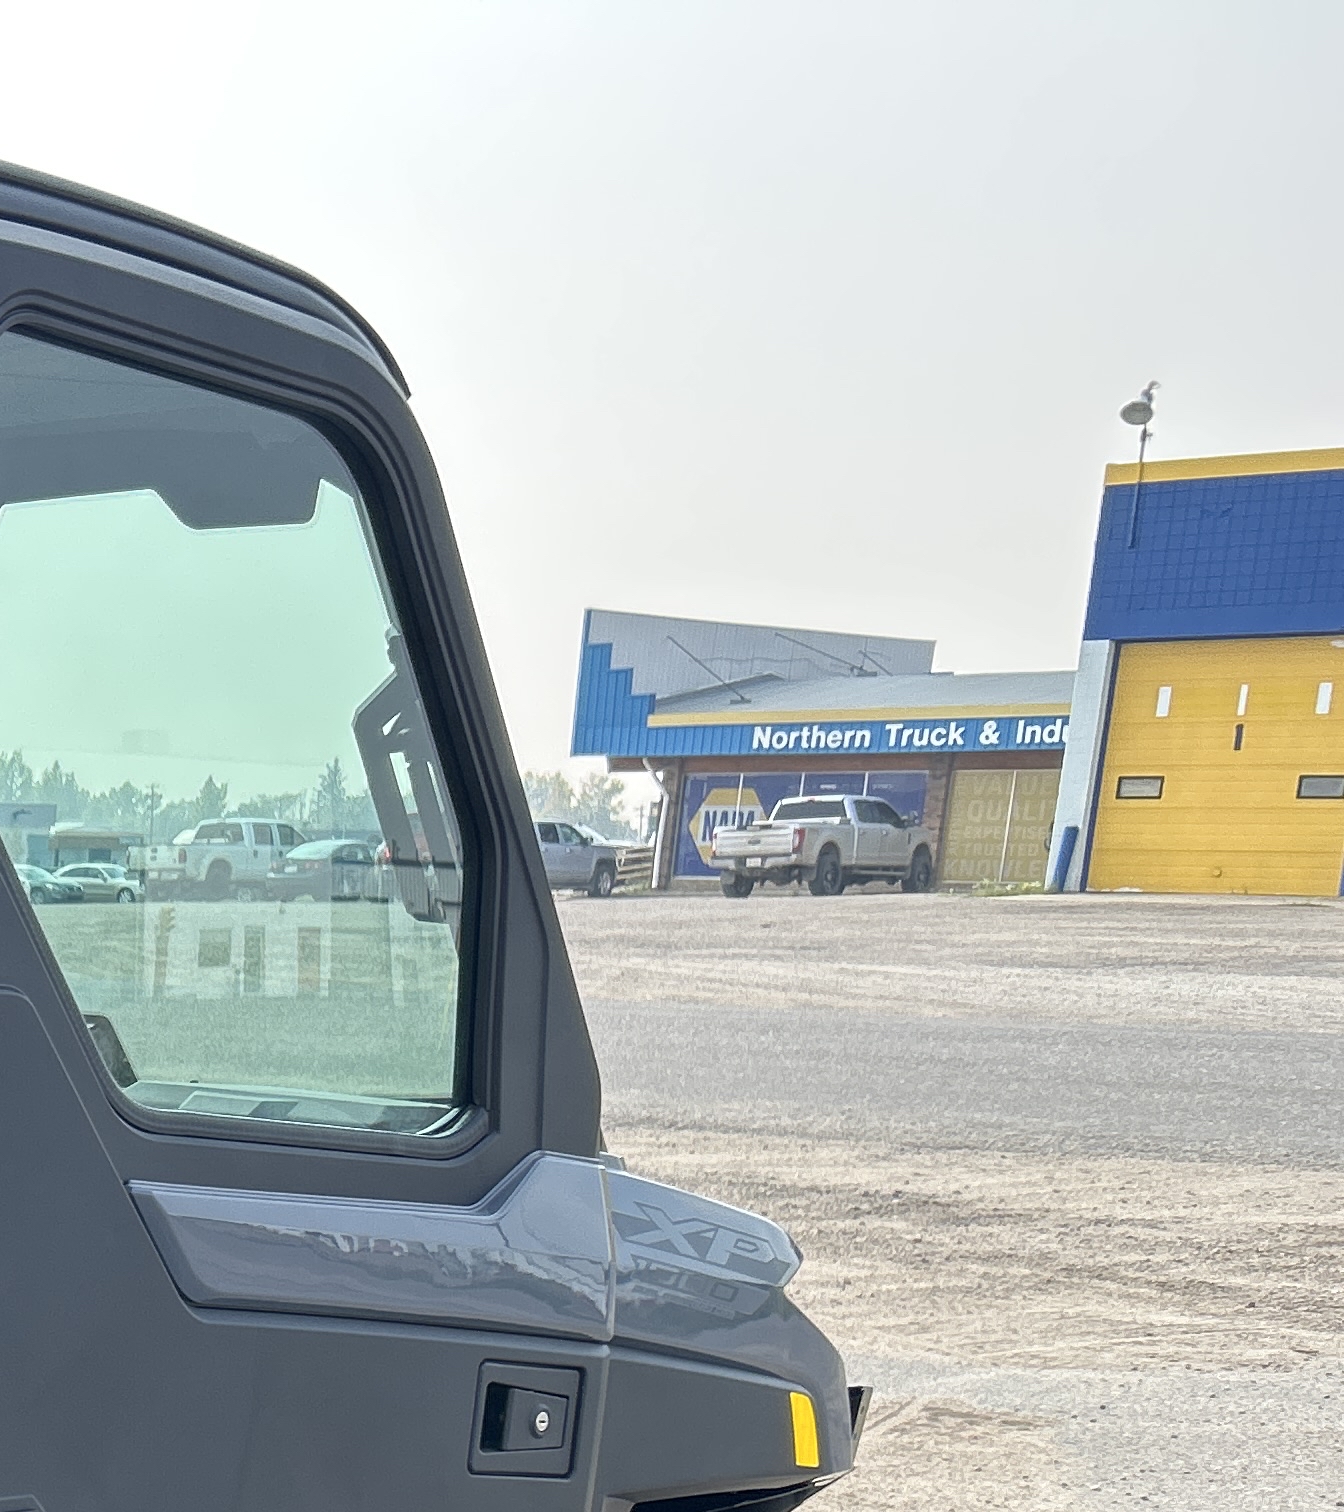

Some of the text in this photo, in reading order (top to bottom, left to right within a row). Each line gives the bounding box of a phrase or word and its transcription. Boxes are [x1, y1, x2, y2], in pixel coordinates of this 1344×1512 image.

[752, 724, 871, 750] Northern
[885, 721, 965, 747] Truck
[979, 720, 1001, 746] &
[967, 799, 1055, 822] QUALI
[964, 825, 1048, 840] EXPETISE
[623, 1200, 776, 1267] XP
